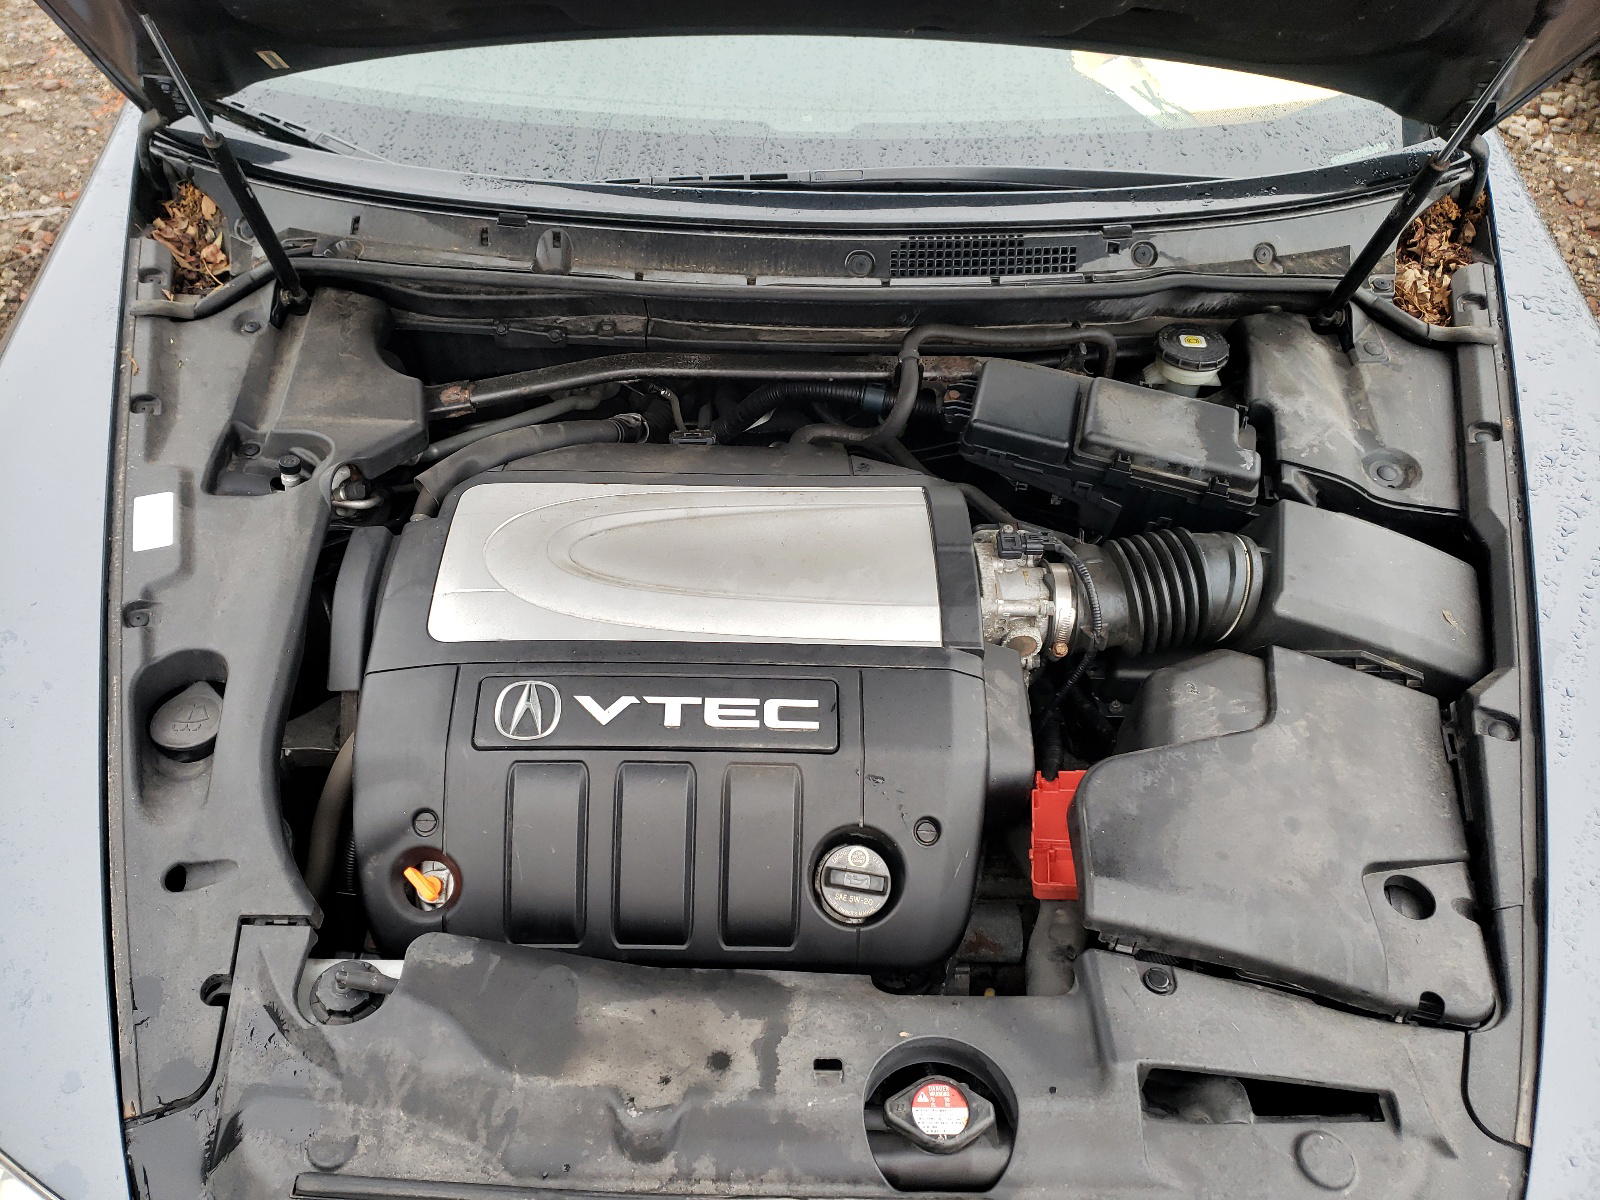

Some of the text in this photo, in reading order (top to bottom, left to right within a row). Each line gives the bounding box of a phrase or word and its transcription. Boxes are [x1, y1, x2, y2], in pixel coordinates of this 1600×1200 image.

[573, 695, 820, 731] VTEC
[834, 893, 848, 902] SAE
[849, 896, 874, 906] 5W-20
